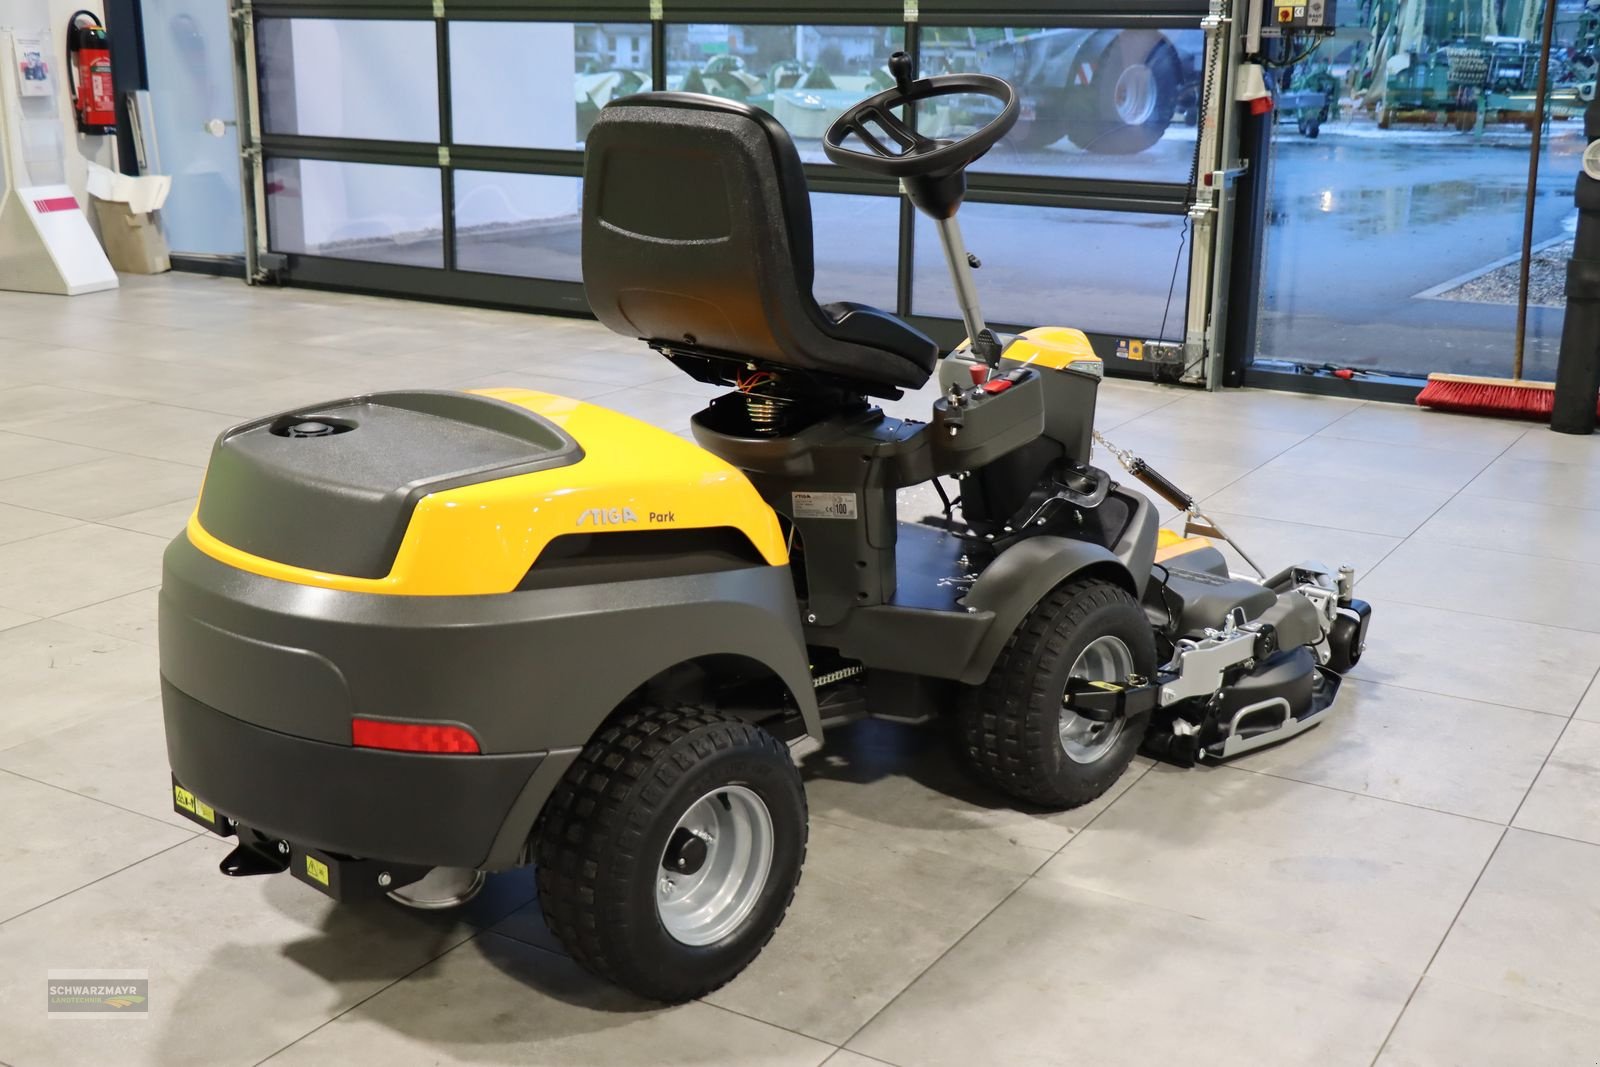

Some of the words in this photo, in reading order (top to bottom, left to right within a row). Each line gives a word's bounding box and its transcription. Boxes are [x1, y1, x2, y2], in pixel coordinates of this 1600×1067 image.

[835, 503, 847, 514] 100
[576, 507, 638, 526] STIGA
[649, 511, 675, 523] Park
